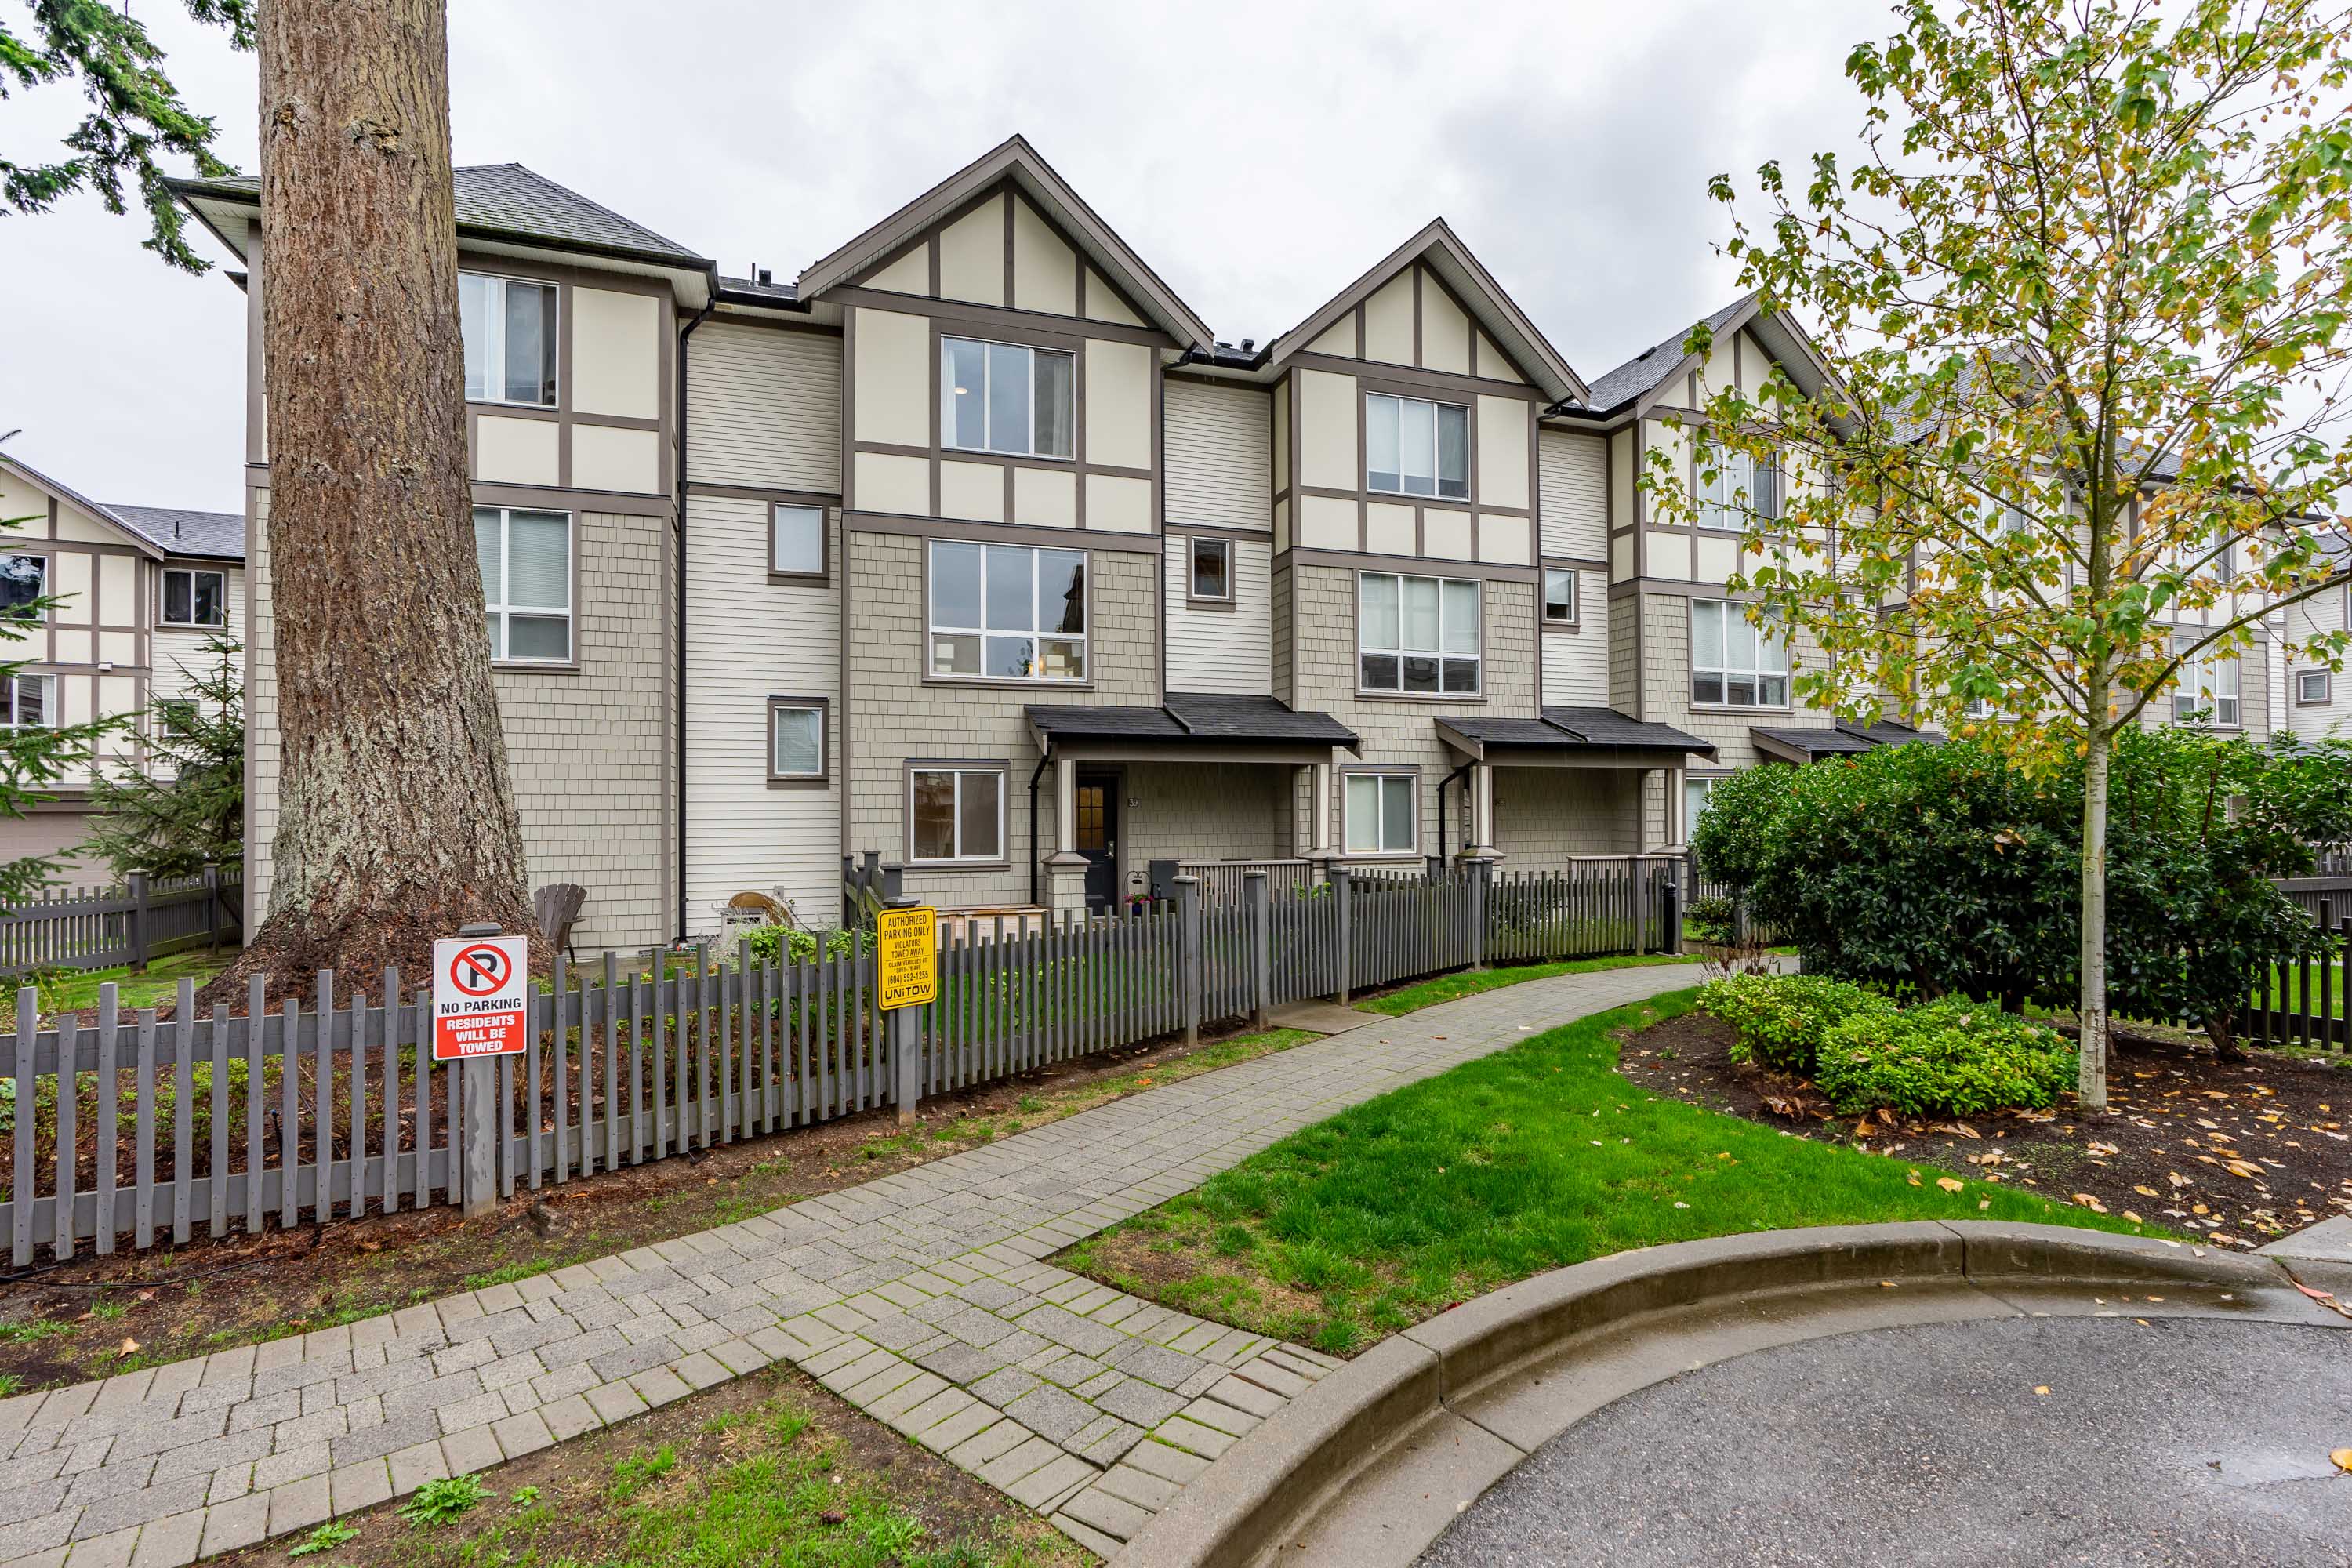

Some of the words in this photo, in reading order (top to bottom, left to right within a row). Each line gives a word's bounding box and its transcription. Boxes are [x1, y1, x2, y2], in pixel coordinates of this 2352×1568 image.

[888, 914, 927, 927] AUTHORIZED
[884, 927, 912, 940] PARKING
[914, 925, 930, 937] ONLY
[895, 938, 921, 949] VIOLATORS
[891, 949, 909, 959] TOWED
[910, 946, 924, 956] AWAY
[887, 974, 902, 985] (604)
[903, 970, 929, 982] 592-1255
[441, 1003, 459, 1014] NO
[465, 998, 521, 1012] PARKING
[446, 1014, 515, 1030] RESIDENTS
[456, 1030, 486, 1042] WILL
[490, 1028, 506, 1039] BE
[459, 1040, 503, 1054] TOWED
